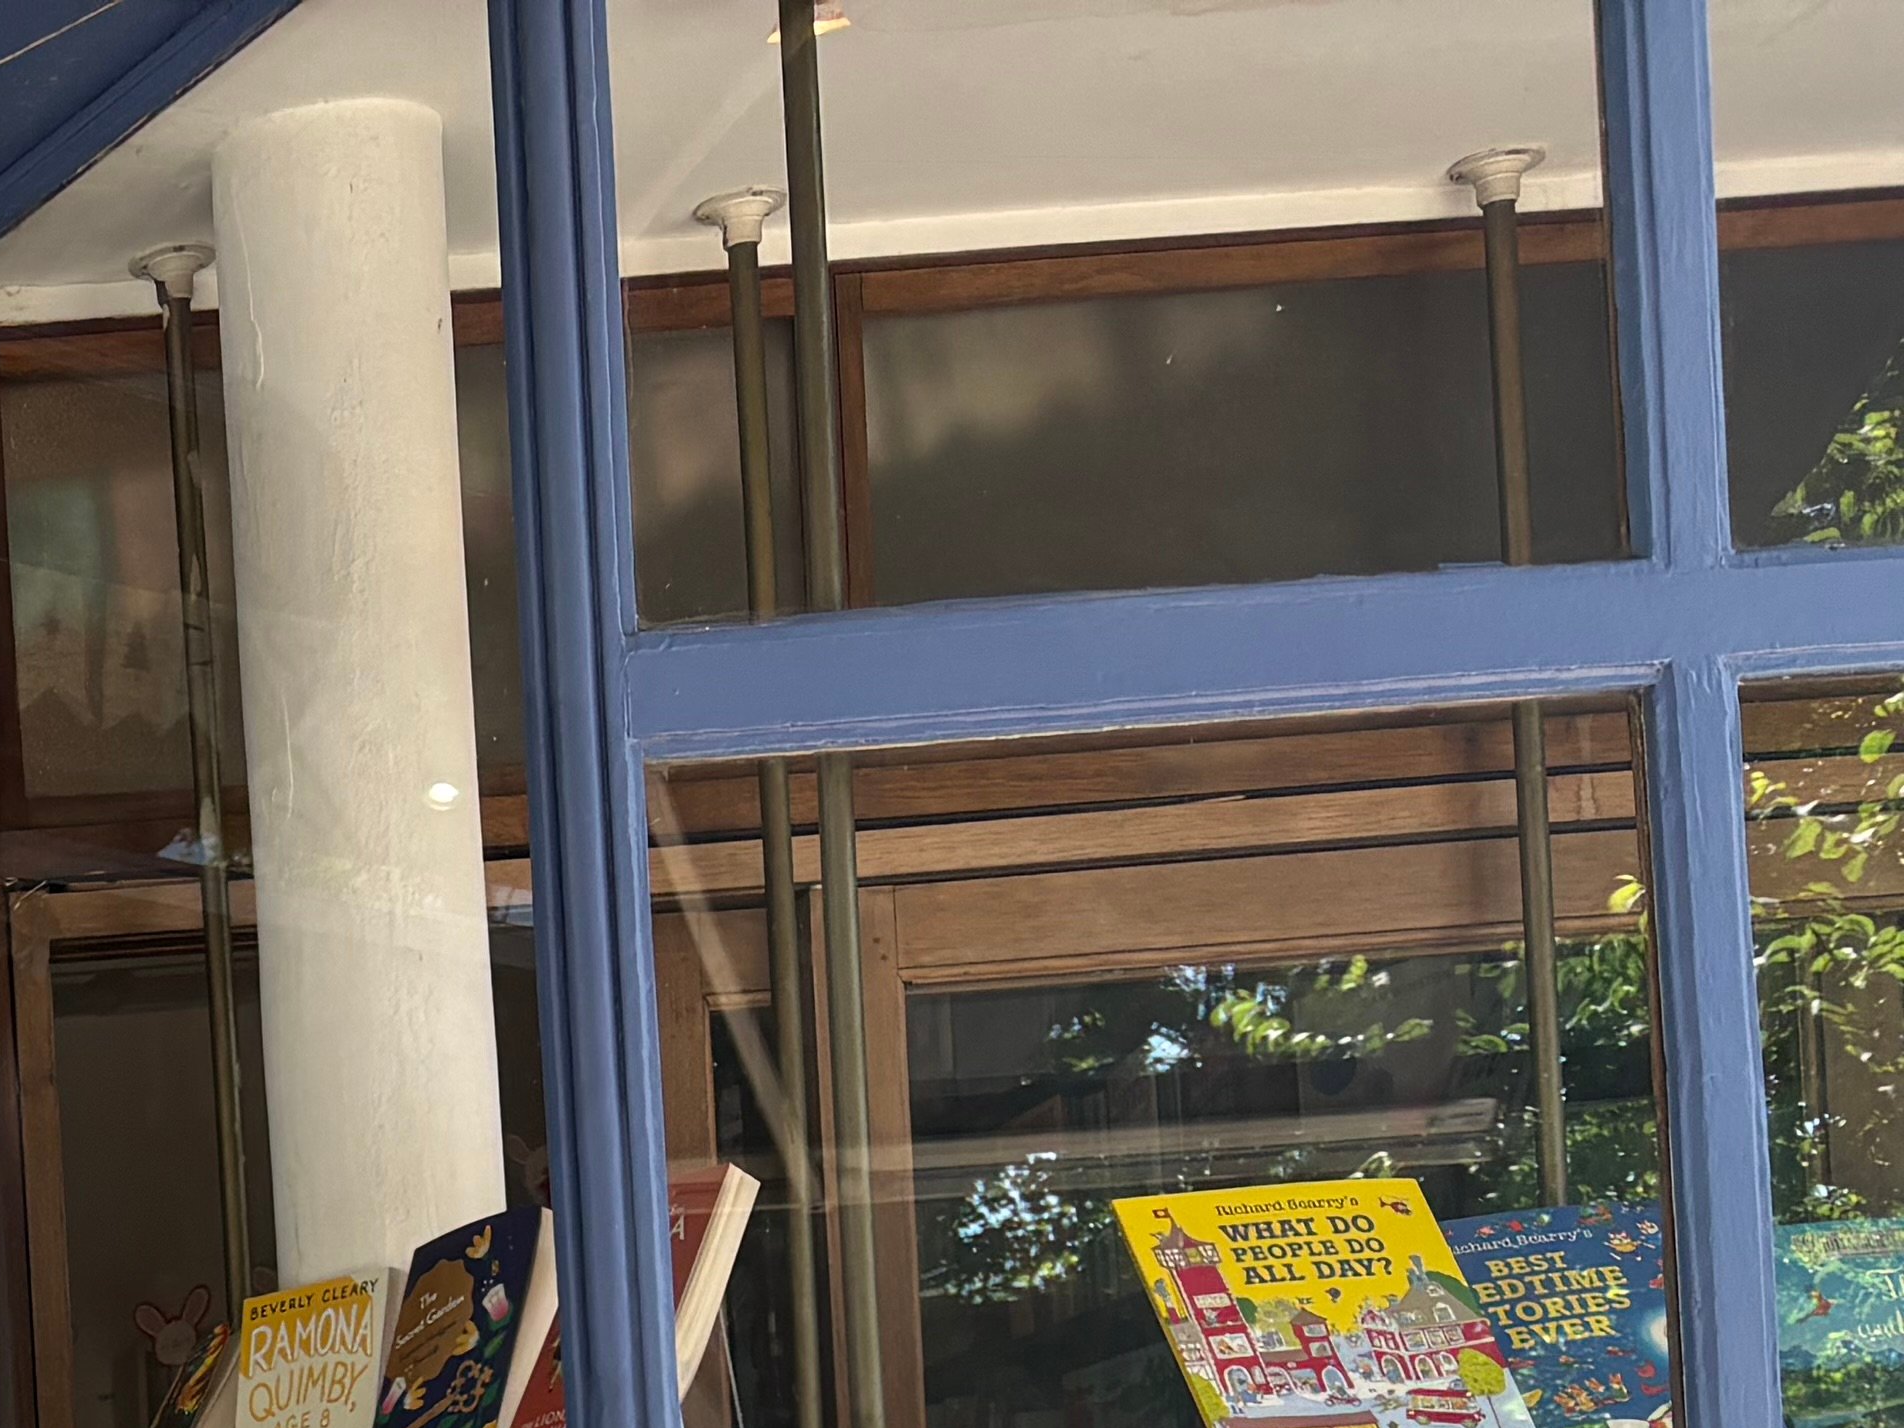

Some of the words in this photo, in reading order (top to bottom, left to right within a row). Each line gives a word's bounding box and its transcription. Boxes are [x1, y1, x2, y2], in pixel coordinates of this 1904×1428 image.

[1218, 1217, 1319, 1243] WHAT
[1326, 1214, 1376, 1235] DO
[1229, 1239, 1340, 1263] PEOPLE
[1342, 1237, 1386, 1255] DO
[1485, 1250, 1568, 1278] BEST
[1242, 1263, 1306, 1286] ALL
[1311, 1256, 1393, 1280] DAY?
[1472, 1265, 1629, 1305] EDTIME
[250, 1293, 314, 1321] BEVERLY
[321, 1278, 379, 1304] CLEARY
[419, 1292, 438, 1311] The
[426, 1293, 466, 1326] Garden
[1488, 1288, 1632, 1327] TORIES
[248, 1306, 373, 1378] RAMONA
[1505, 1314, 1621, 1350] EVER
[248, 1362, 371, 1423] QUIMBY,
[320, 1407, 331, 1427] 8
